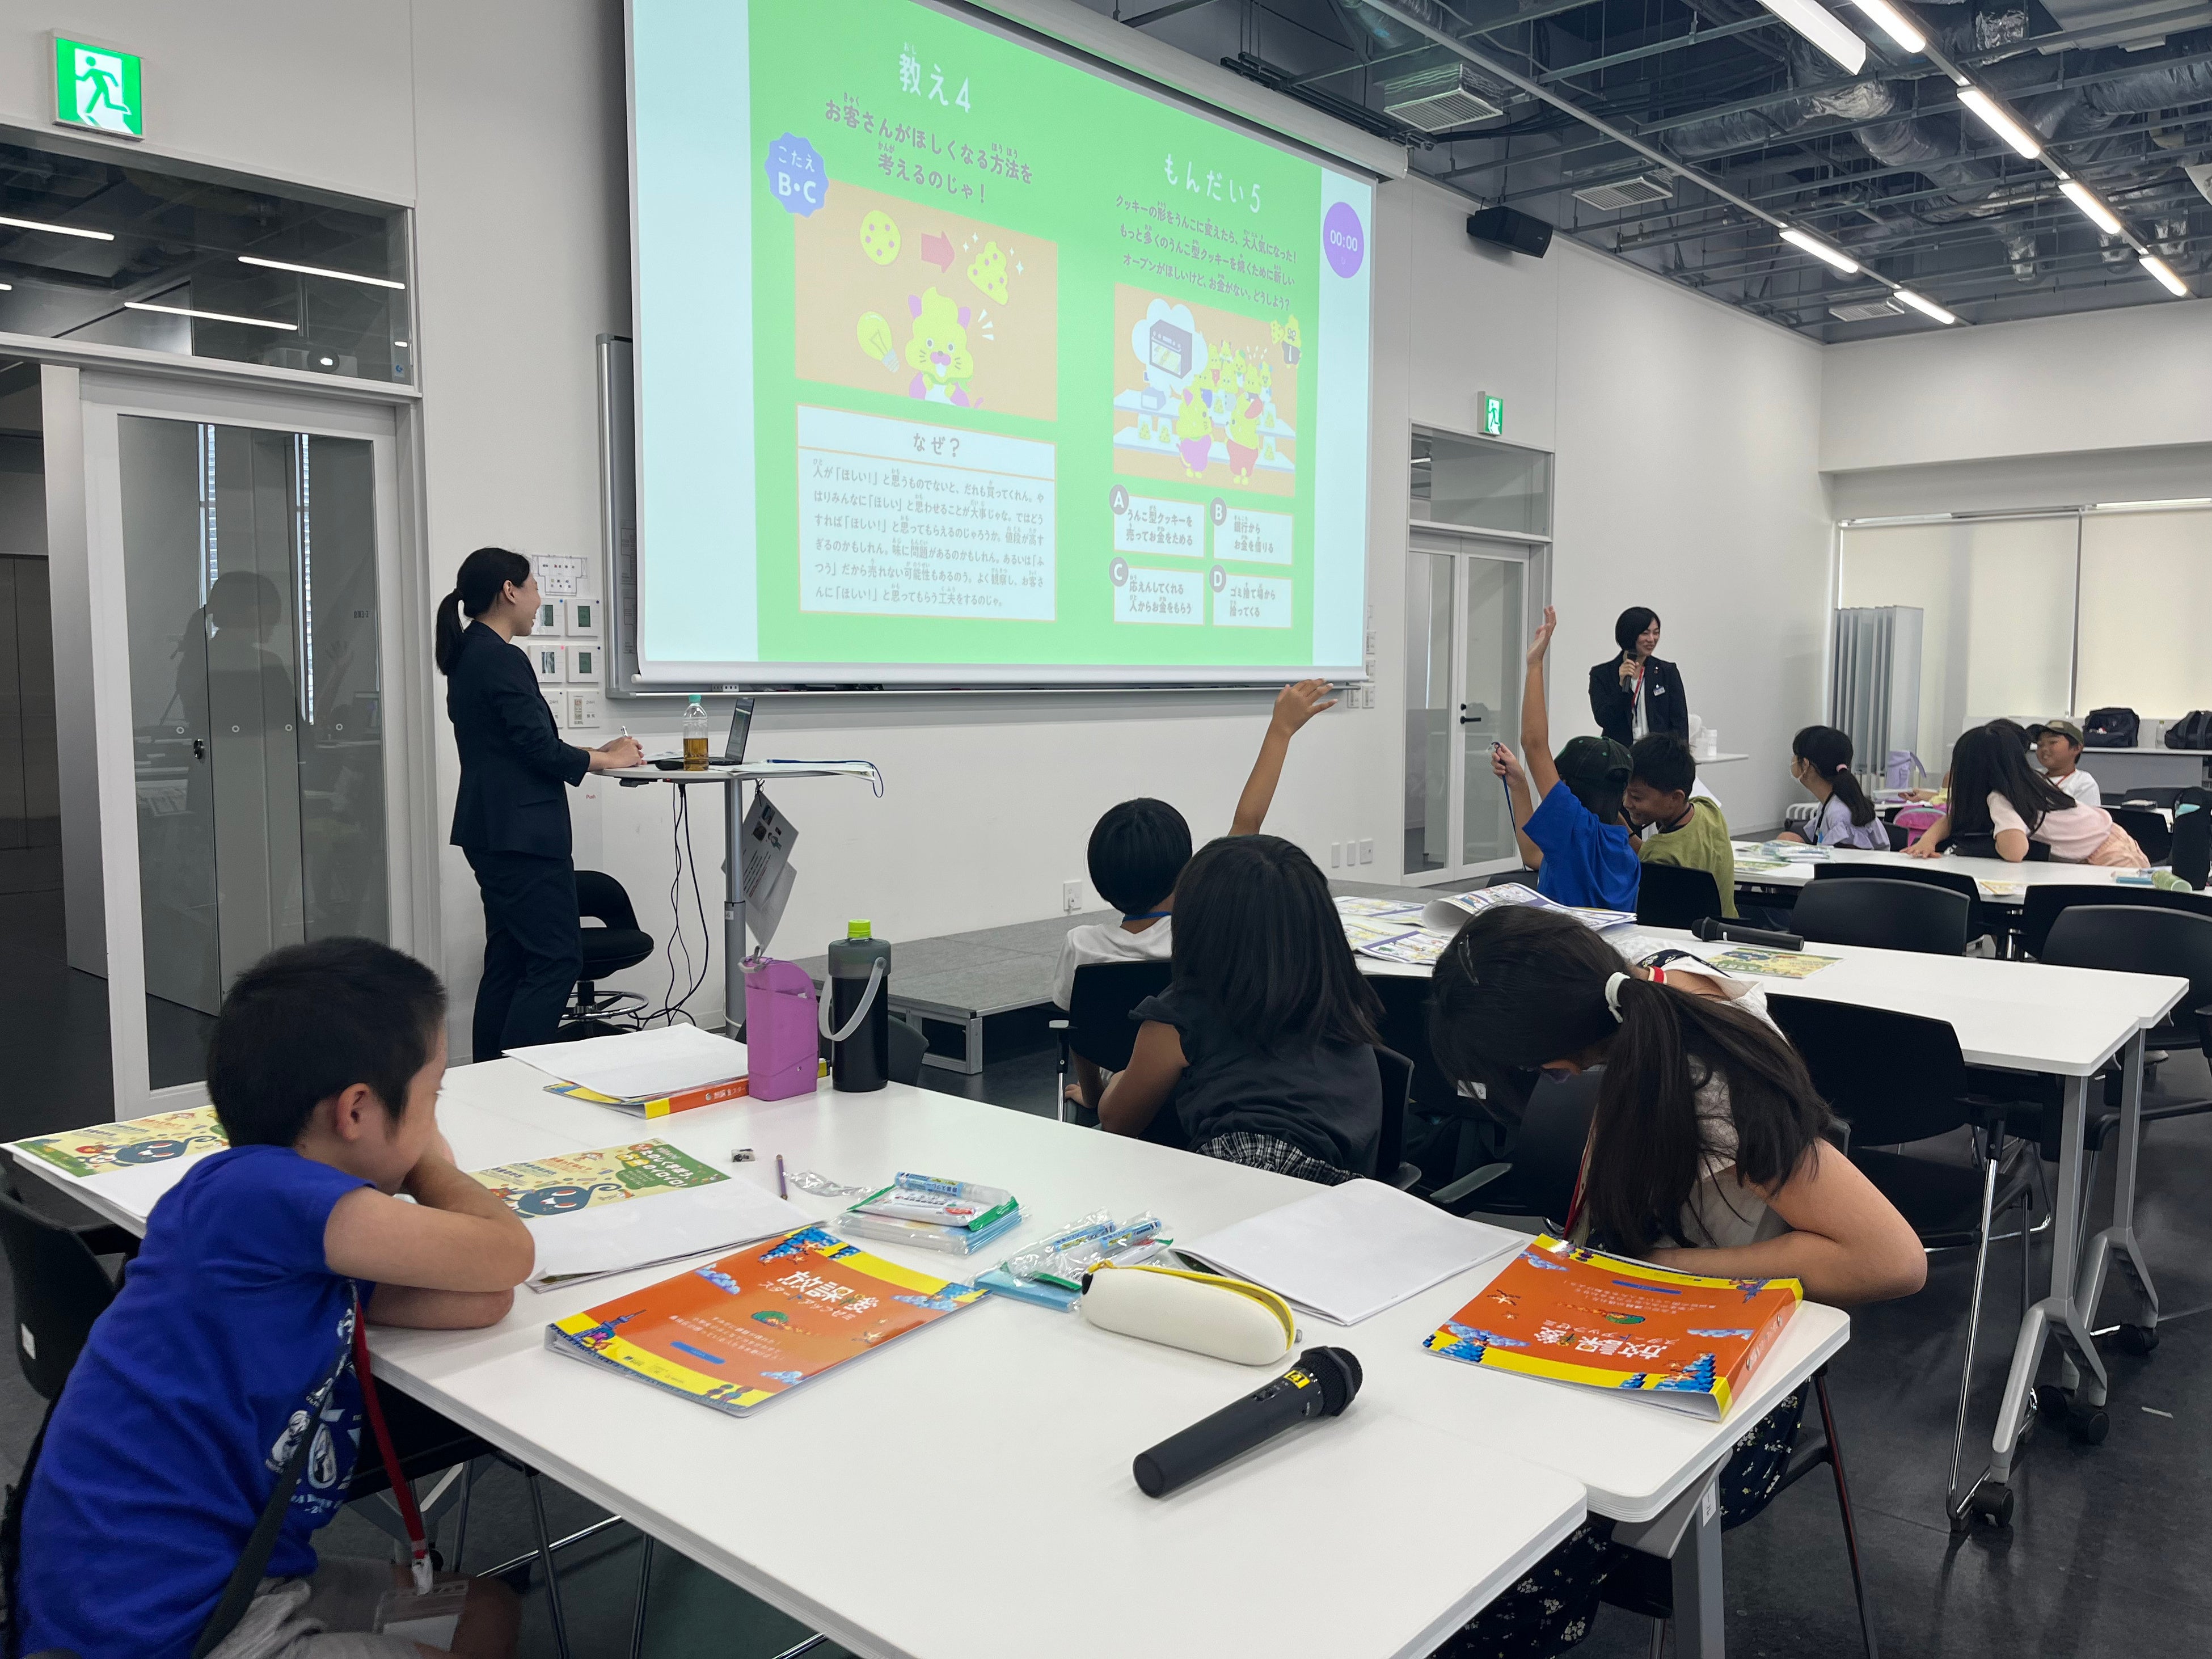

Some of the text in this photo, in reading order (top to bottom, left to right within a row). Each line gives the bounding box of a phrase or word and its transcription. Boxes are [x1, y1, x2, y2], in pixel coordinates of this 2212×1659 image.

[900, 53, 970, 113] 教え4
[825, 99, 1032, 184] お客さんがほしくなる方法を
[778, 145, 815, 172] こたえ
[878, 153, 985, 204] 考えるのじゃ！
[1164, 154, 1260, 213] もんだい5
[1116, 195, 1296, 264] クッキーの形をうんこに変えたら、大人気になった！
[1330, 230, 1358, 252] 00:00
[1120, 223, 1295, 285] もっと多くのうんこ型クッキーを焼くために新しい
[1123, 253, 1290, 311] オーブンがほしいけど、お金がない。どうしよう？
[914, 433, 960, 457] なぜ？
[1113, 491, 1124, 508] A
[1128, 509, 1192, 527] うんこ型クッキーを
[1215, 504, 1223, 521] B
[1126, 529, 1193, 546] 売ってお金をためる
[1234, 521, 1261, 534] 銀行から
[1234, 539, 1273, 553] お金を借りる
[1114, 564, 1123, 580] C
[1214, 571, 1222, 586] D
[1129, 581, 1184, 595] 応えんしてくれる
[1230, 586, 1276, 600] ゴミ捨て場から
[1129, 601, 1192, 614] 人からお金をもらう
[1230, 603, 1260, 617] 拾ってくる
[777, 1271, 879, 1313] 放課後
[1534, 1327, 1668, 1360] 放課後
